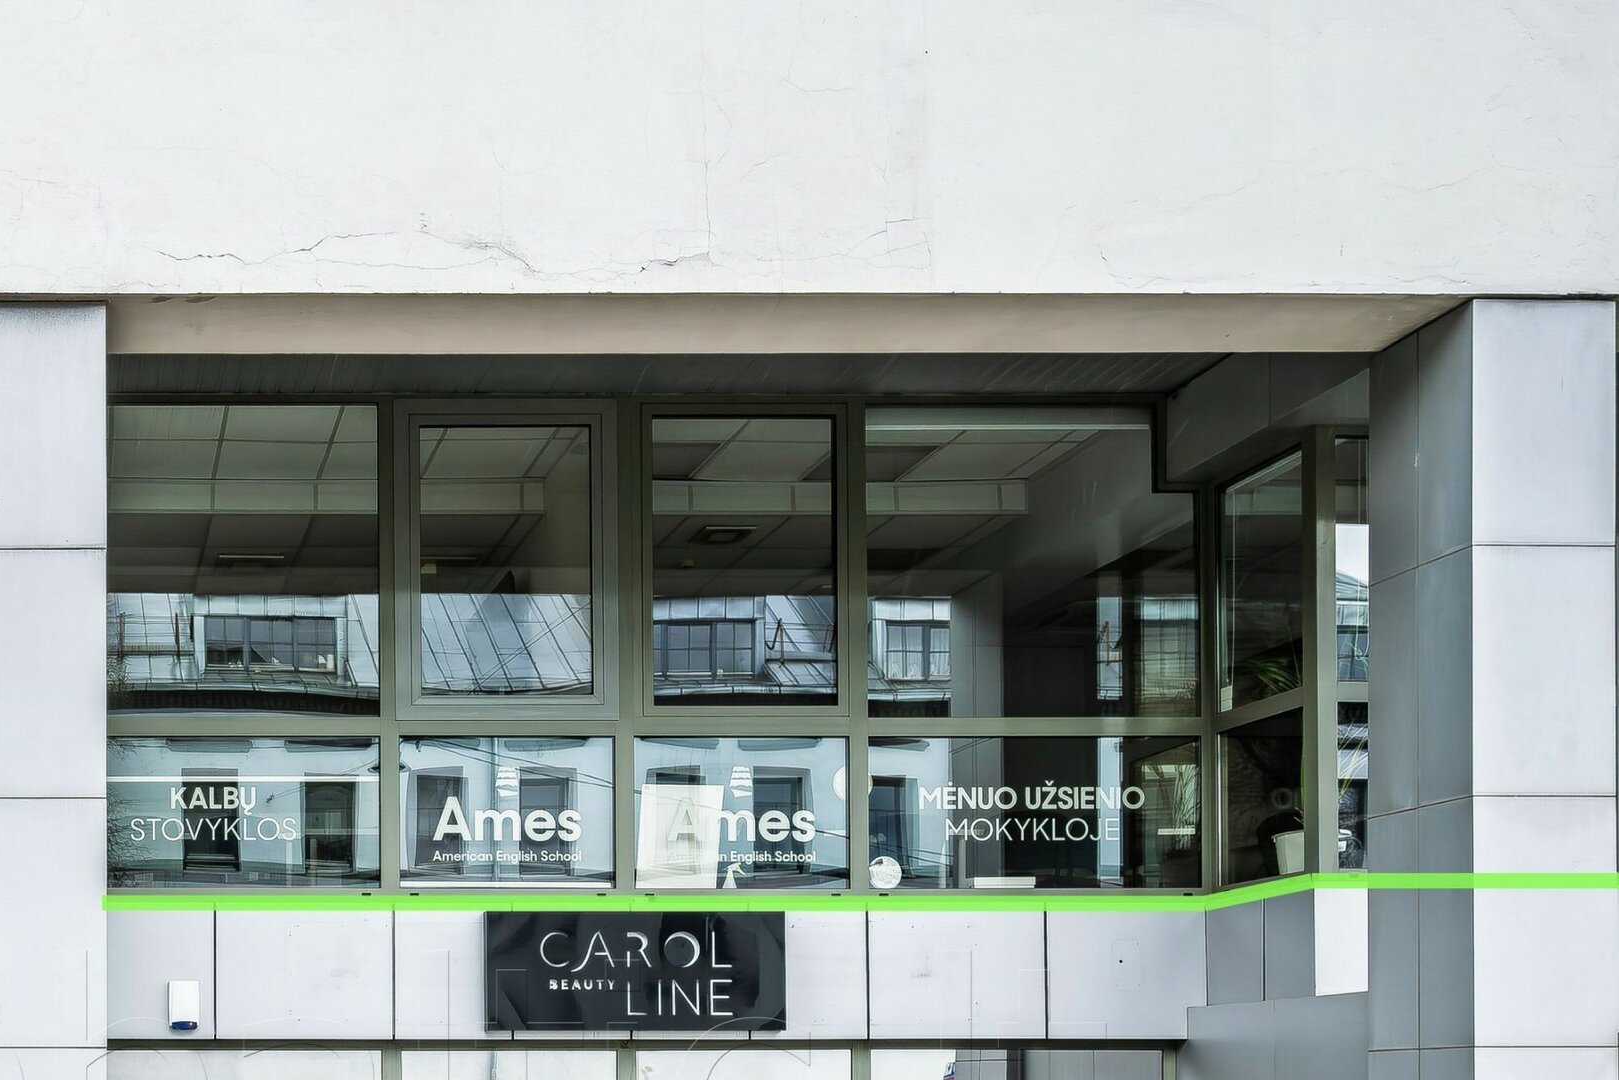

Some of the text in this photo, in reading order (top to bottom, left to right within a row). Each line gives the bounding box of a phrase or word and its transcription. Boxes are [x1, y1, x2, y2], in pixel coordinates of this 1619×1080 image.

[169, 786, 258, 816] KALBŲ
[919, 780, 1146, 811] MĖNUO UŽSIENIO
[130, 817, 297, 842] STOVYKLOS
[432, 796, 582, 843] Ames
[668, 796, 817, 843] Ames
[945, 817, 1120, 842] MOKYKLOJE
[432, 850, 582, 865] American English School
[730, 850, 772, 865] English
[775, 850, 817, 863] School
[539, 930, 733, 973] CAROL
[548, 978, 615, 991] BEAUTY
[627, 978, 735, 1016] LINE
